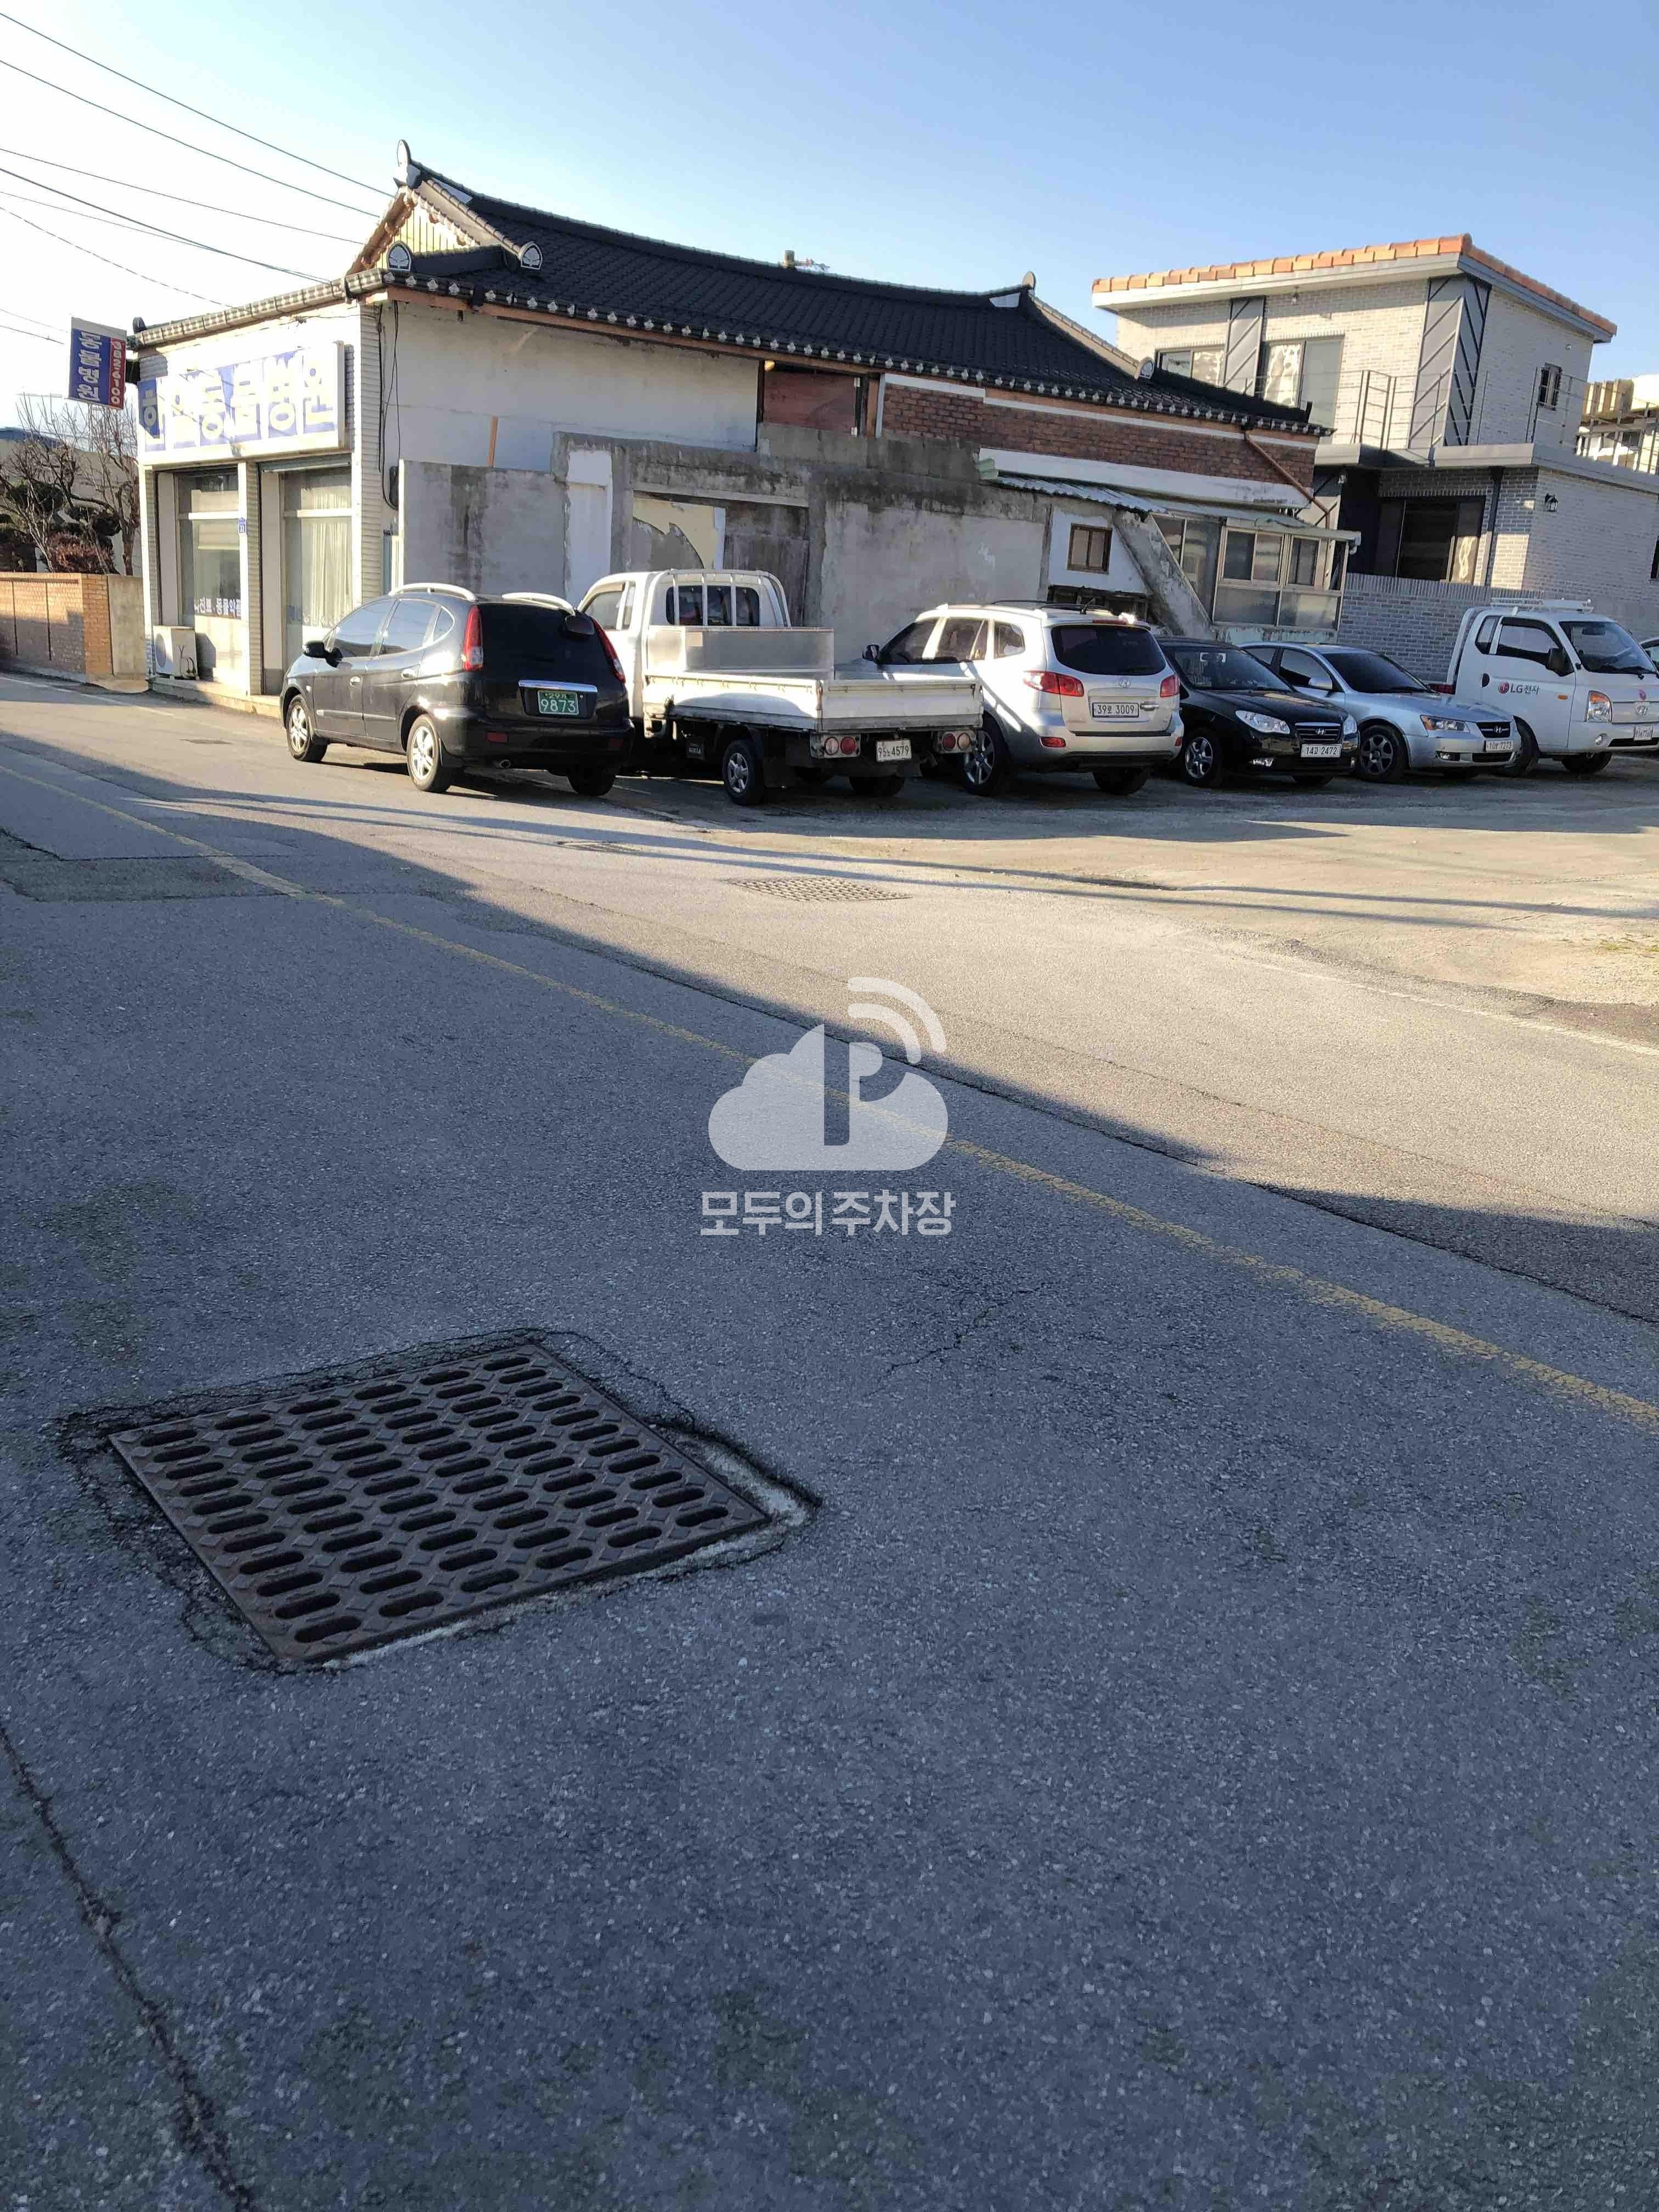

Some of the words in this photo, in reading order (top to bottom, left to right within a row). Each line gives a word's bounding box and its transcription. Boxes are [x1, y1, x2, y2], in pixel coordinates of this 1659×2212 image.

[77, 330, 102, 401] 동물병원
[1510, 684, 1540, 695] LG전자
[541, 699, 575, 713] 9873
[1115, 704, 1135, 714] 3009
[1321, 746, 1337, 755] 2472
